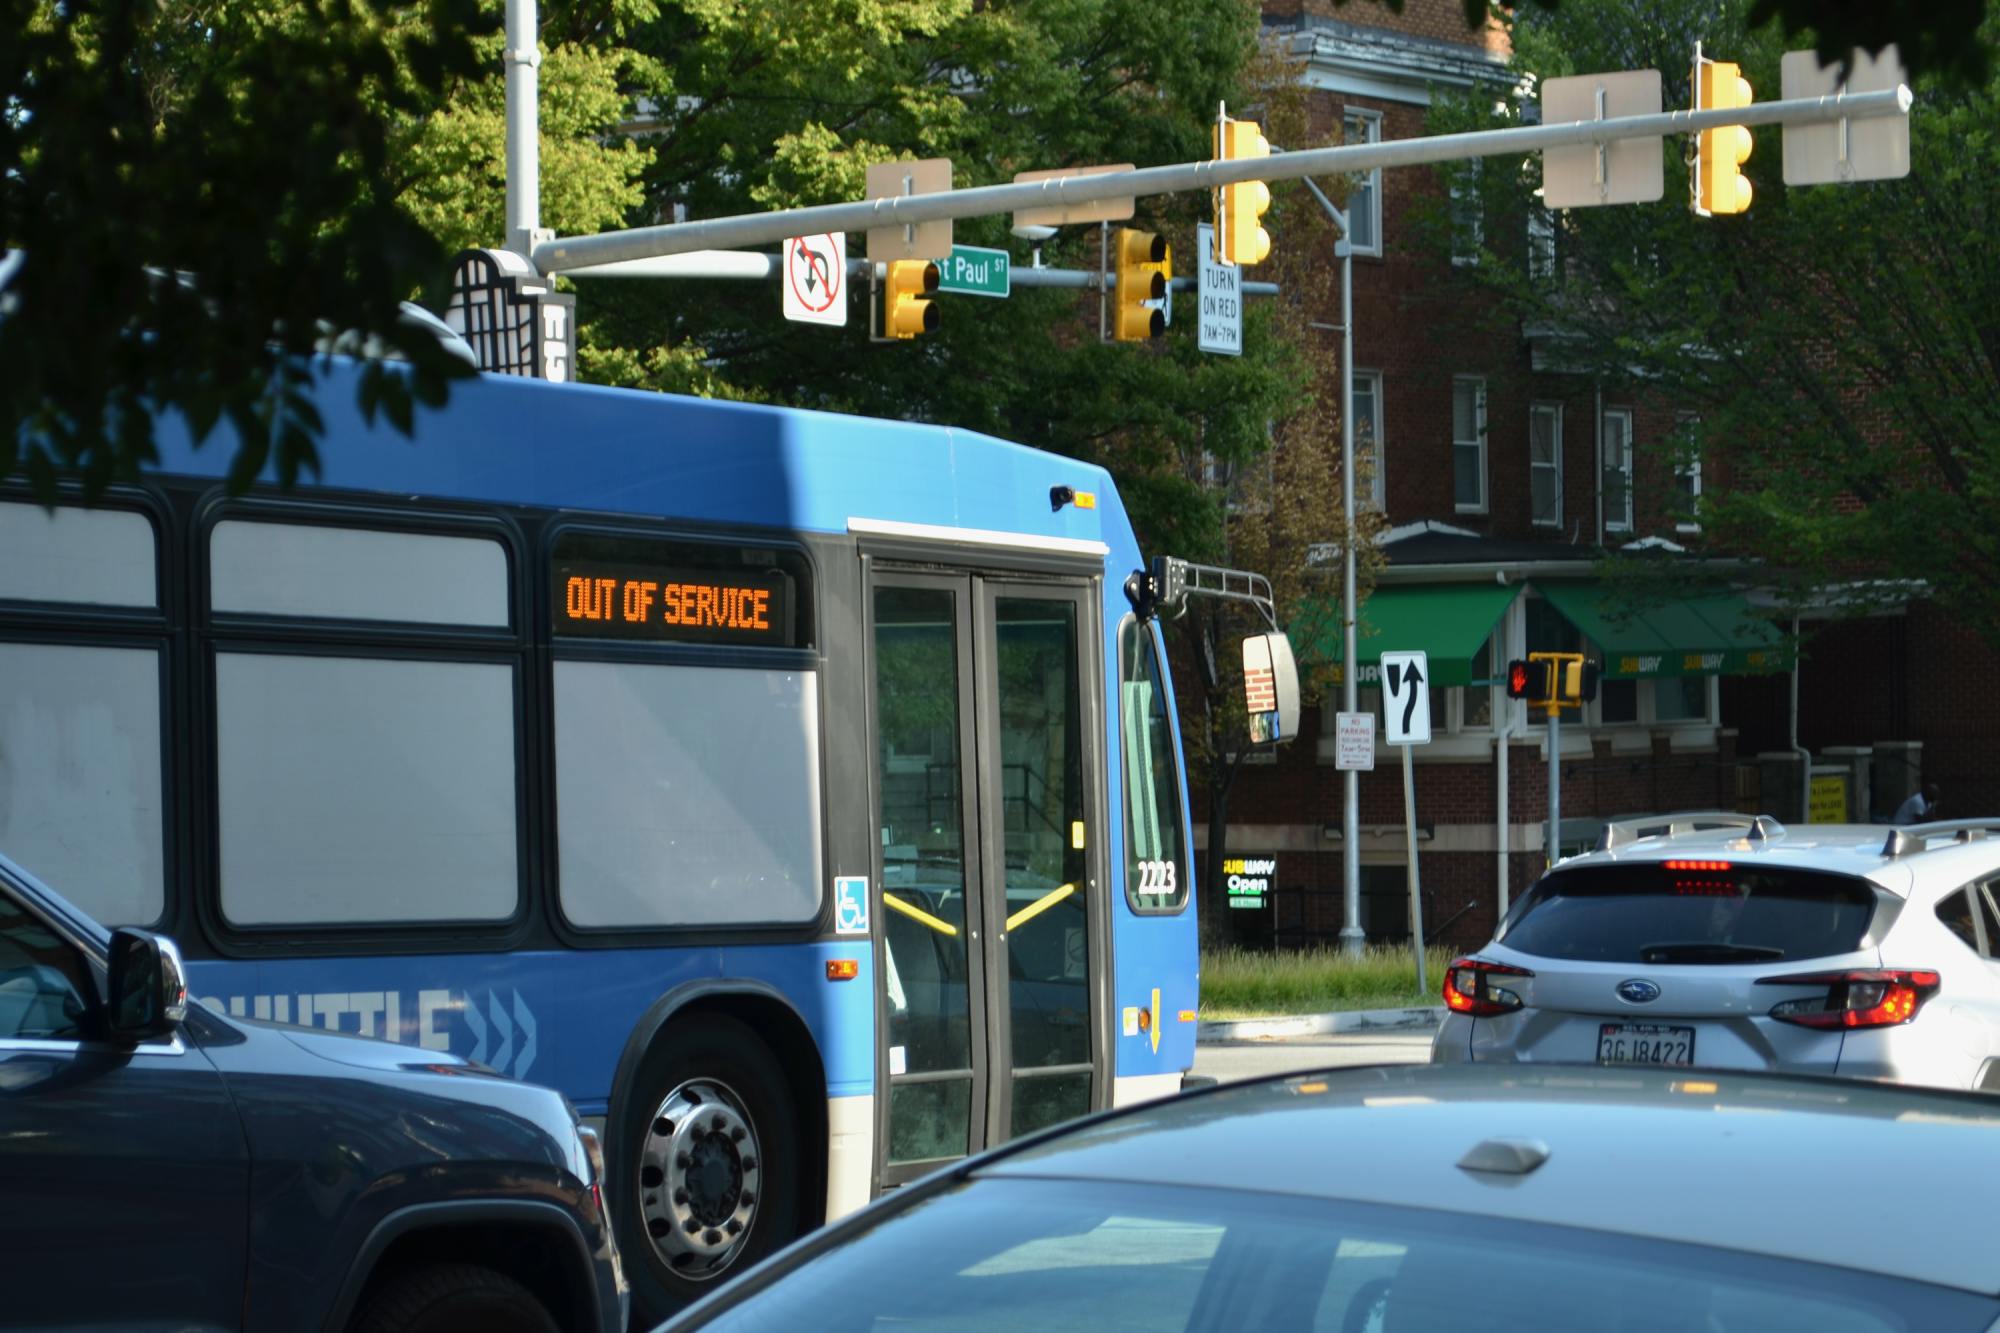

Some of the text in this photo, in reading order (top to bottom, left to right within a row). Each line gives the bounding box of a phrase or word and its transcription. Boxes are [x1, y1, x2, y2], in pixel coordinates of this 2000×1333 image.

[956, 256, 988, 284] Paul
[994, 258, 1004, 272] ST
[1206, 268, 1234, 291] TURN
[1203, 295, 1236, 319] ON RED
[567, 577, 769, 629] OUT OF SERVICE
[1620, 656, 1662, 673] SUBWAY
[1683, 653, 1725, 670] SUBWAY
[1138, 860, 1176, 895] 2223
[1227, 875, 1268, 895] Open
